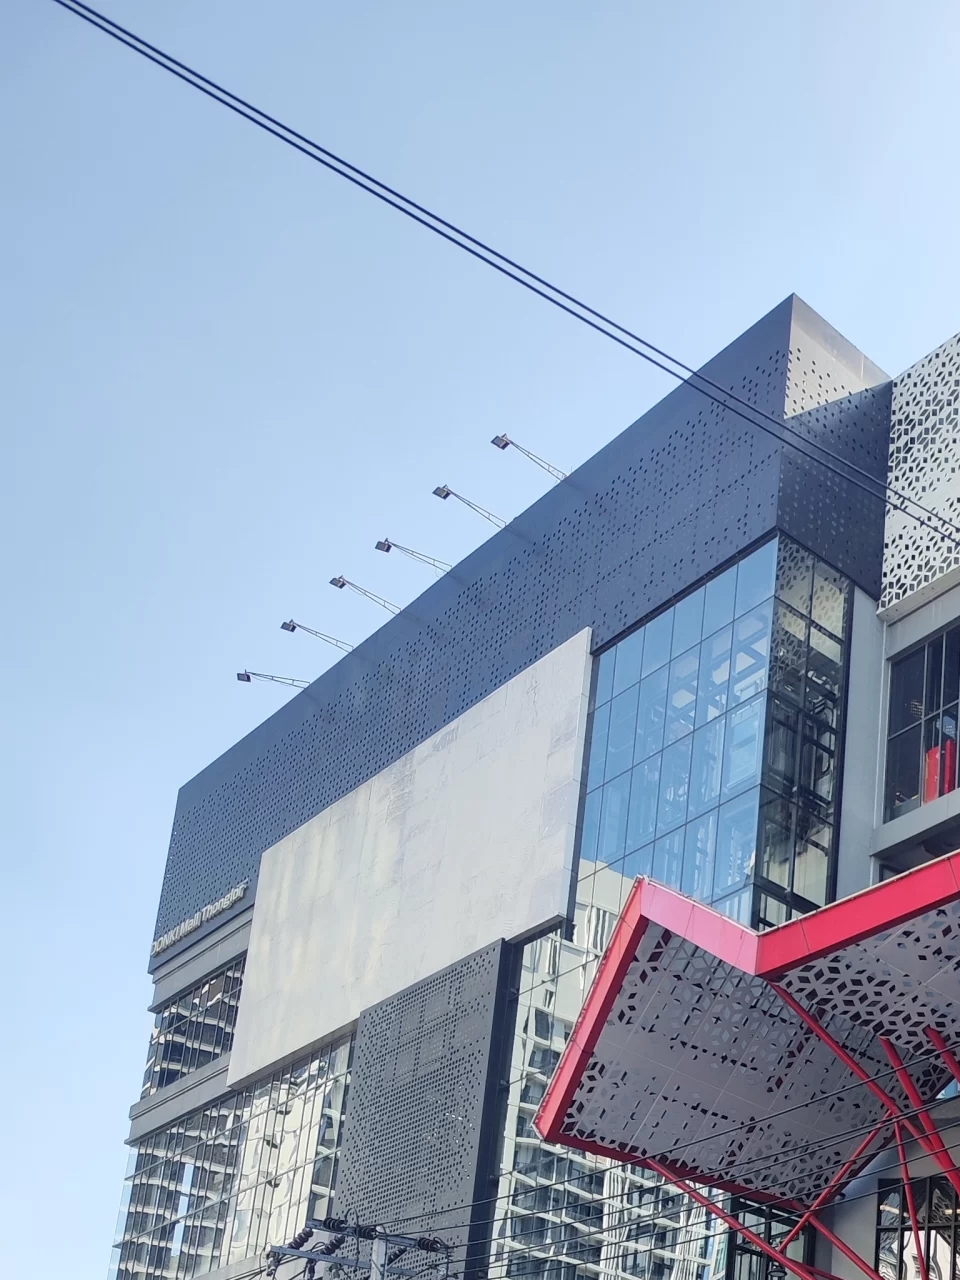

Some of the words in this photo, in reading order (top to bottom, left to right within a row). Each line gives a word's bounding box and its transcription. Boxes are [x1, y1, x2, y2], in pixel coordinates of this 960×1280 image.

[151, 926, 180, 956] DONKI
[180, 911, 201, 937] Mall
[201, 884, 246, 922] Thonglor
